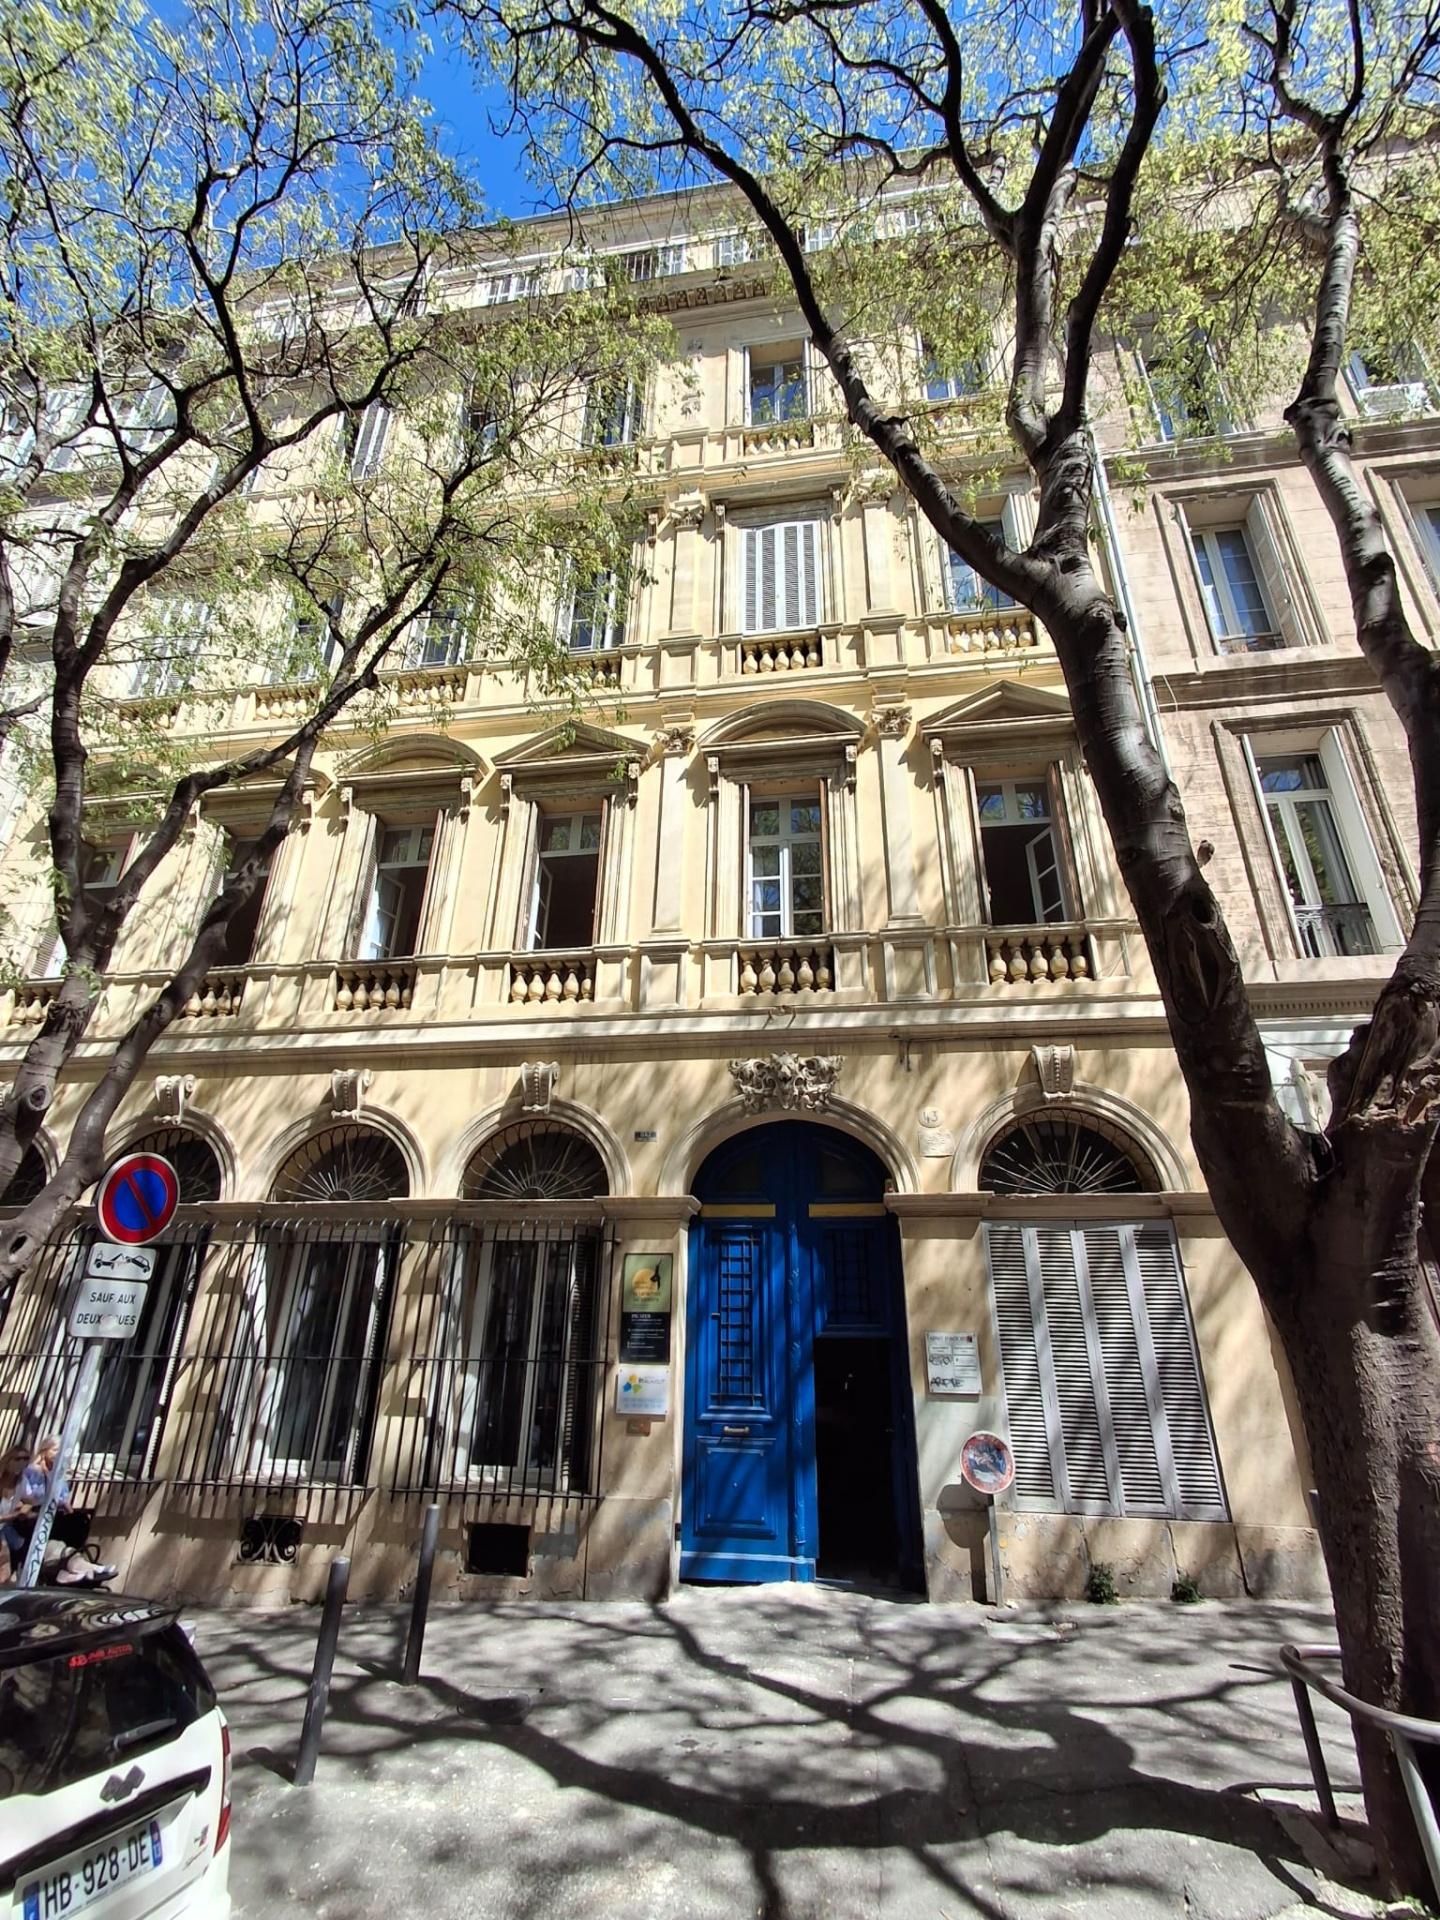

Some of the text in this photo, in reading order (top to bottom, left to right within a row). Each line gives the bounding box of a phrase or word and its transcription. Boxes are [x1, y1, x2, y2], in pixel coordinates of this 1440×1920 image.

[89, 1291, 137, 1304] SAUF AUX
[76, 1312, 137, 1326] DEUX UES
[44, 1829, 150, 1918] HB-928-DE
